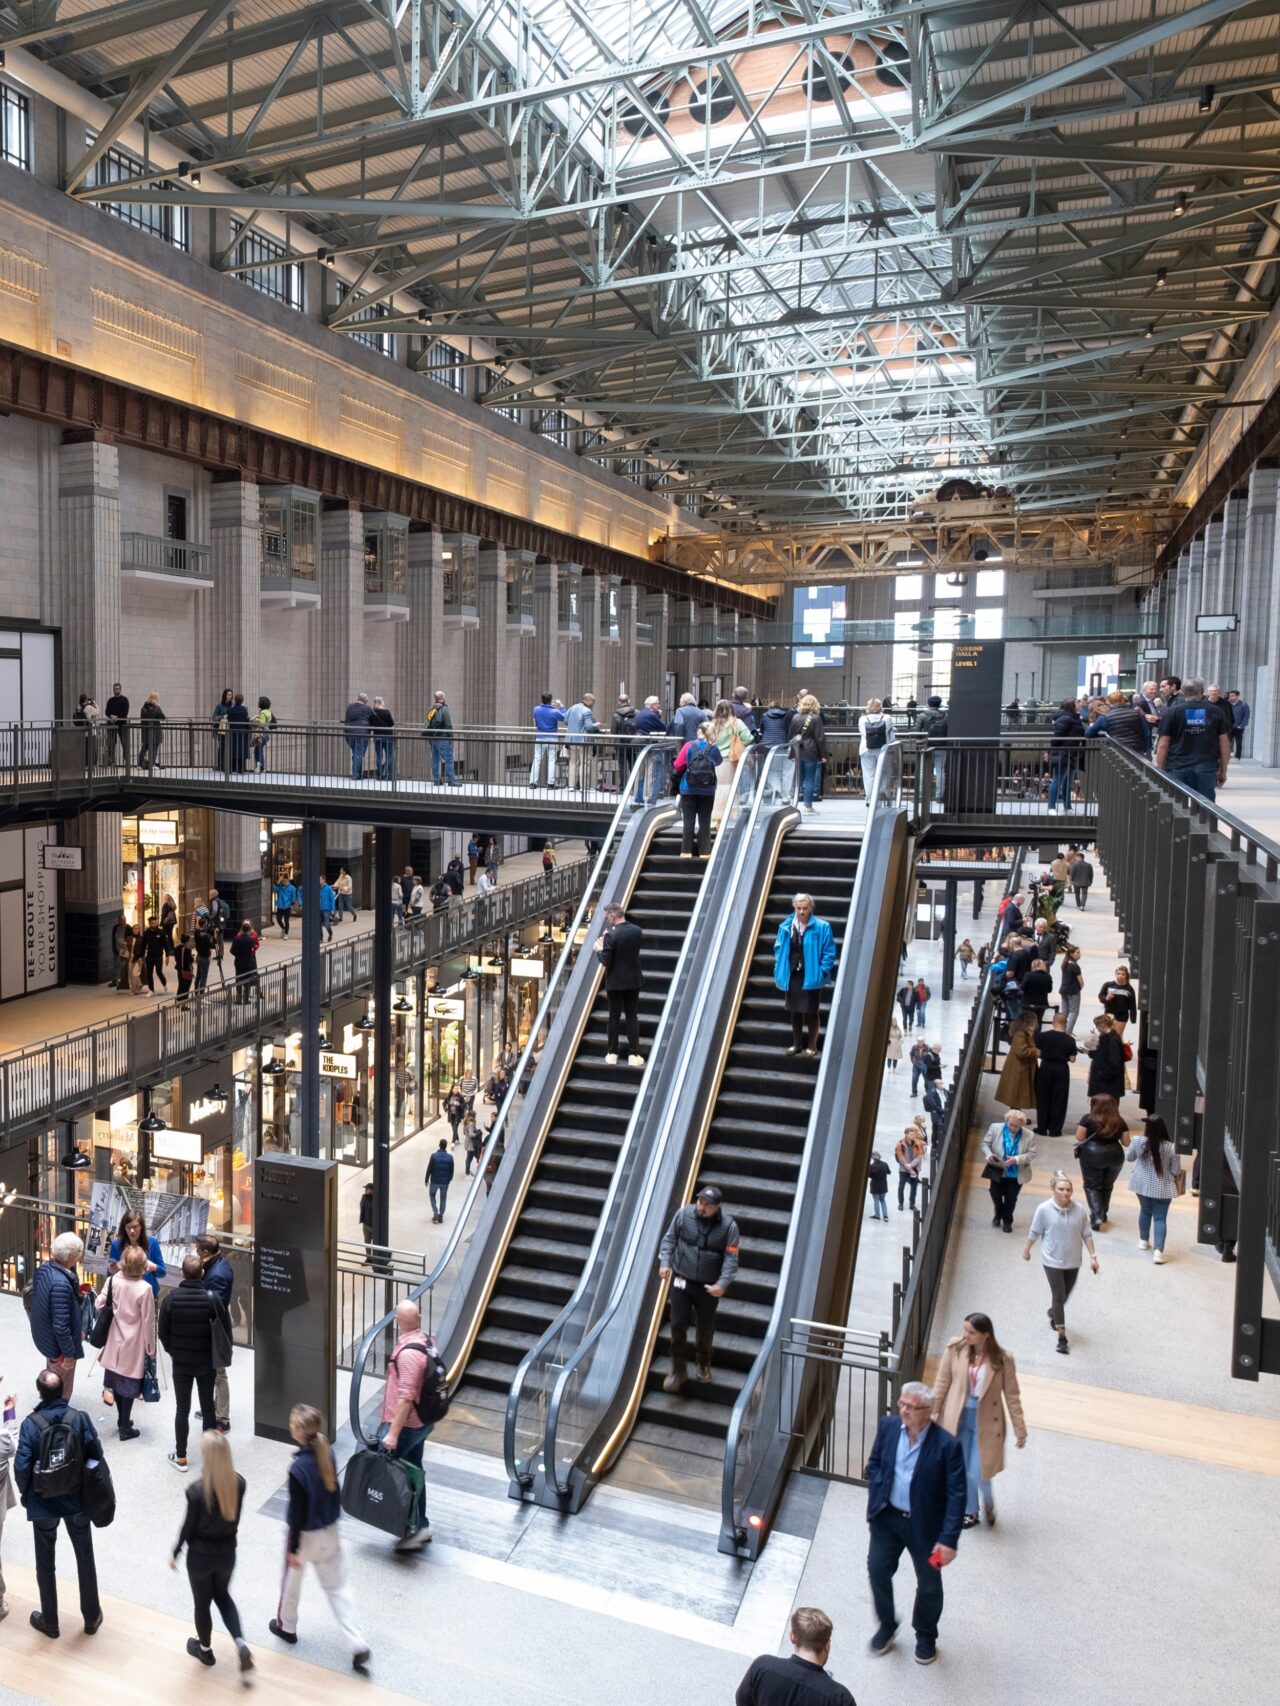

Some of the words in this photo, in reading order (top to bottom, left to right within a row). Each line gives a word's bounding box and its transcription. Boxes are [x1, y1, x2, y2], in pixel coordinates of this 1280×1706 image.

[37, 840, 45, 925] SHOPPING
[27, 891, 35, 978] RE-ROUTE
[38, 931, 46, 975] YOUR
[48, 904, 56, 972] CIRCUIT
[322, 1063, 349, 1075] KOOPLES
[323, 1055, 334, 1066] THE
[367, 1487, 384, 1501] M&S
